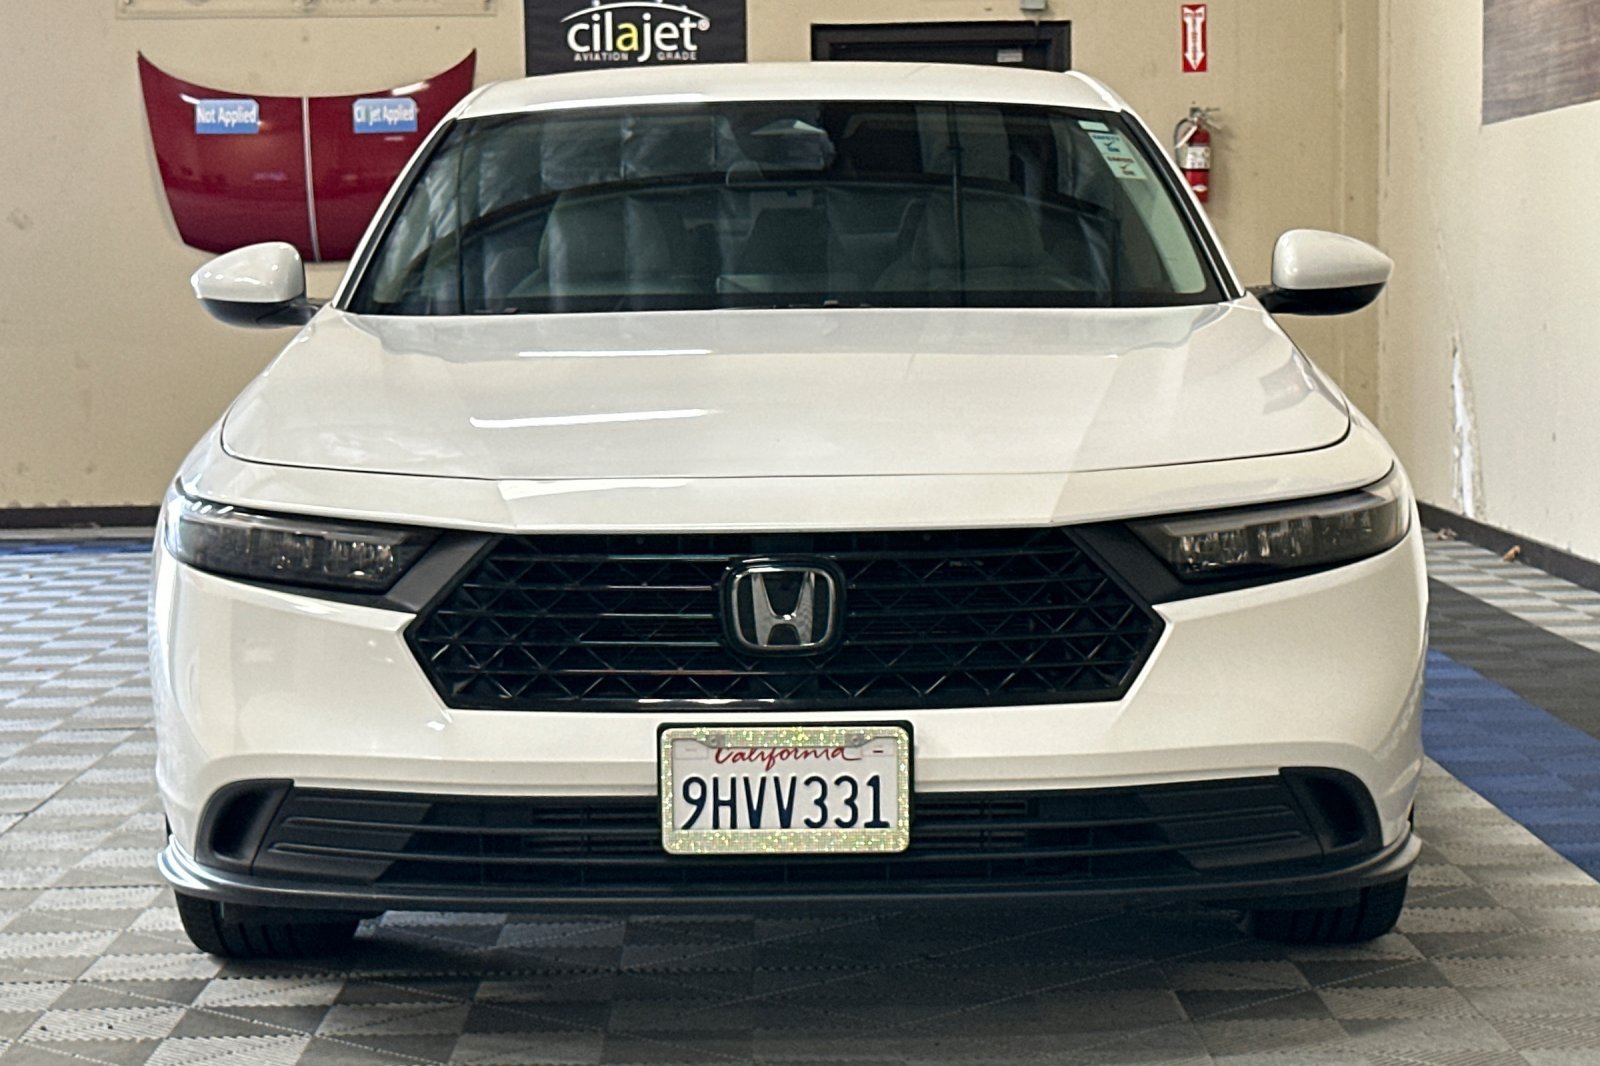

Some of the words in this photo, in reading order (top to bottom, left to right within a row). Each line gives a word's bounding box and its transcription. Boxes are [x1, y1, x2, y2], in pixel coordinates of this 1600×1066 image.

[566, 12, 698, 63] cilajet
[573, 52, 628, 61] AVIATION
[657, 51, 697, 61] GRADE
[196, 107, 216, 124] Not
[218, 105, 257, 127] Applied
[383, 104, 415, 125] Applied
[715, 746, 862, 772] California
[681, 775, 890, 830] 9HVV331
